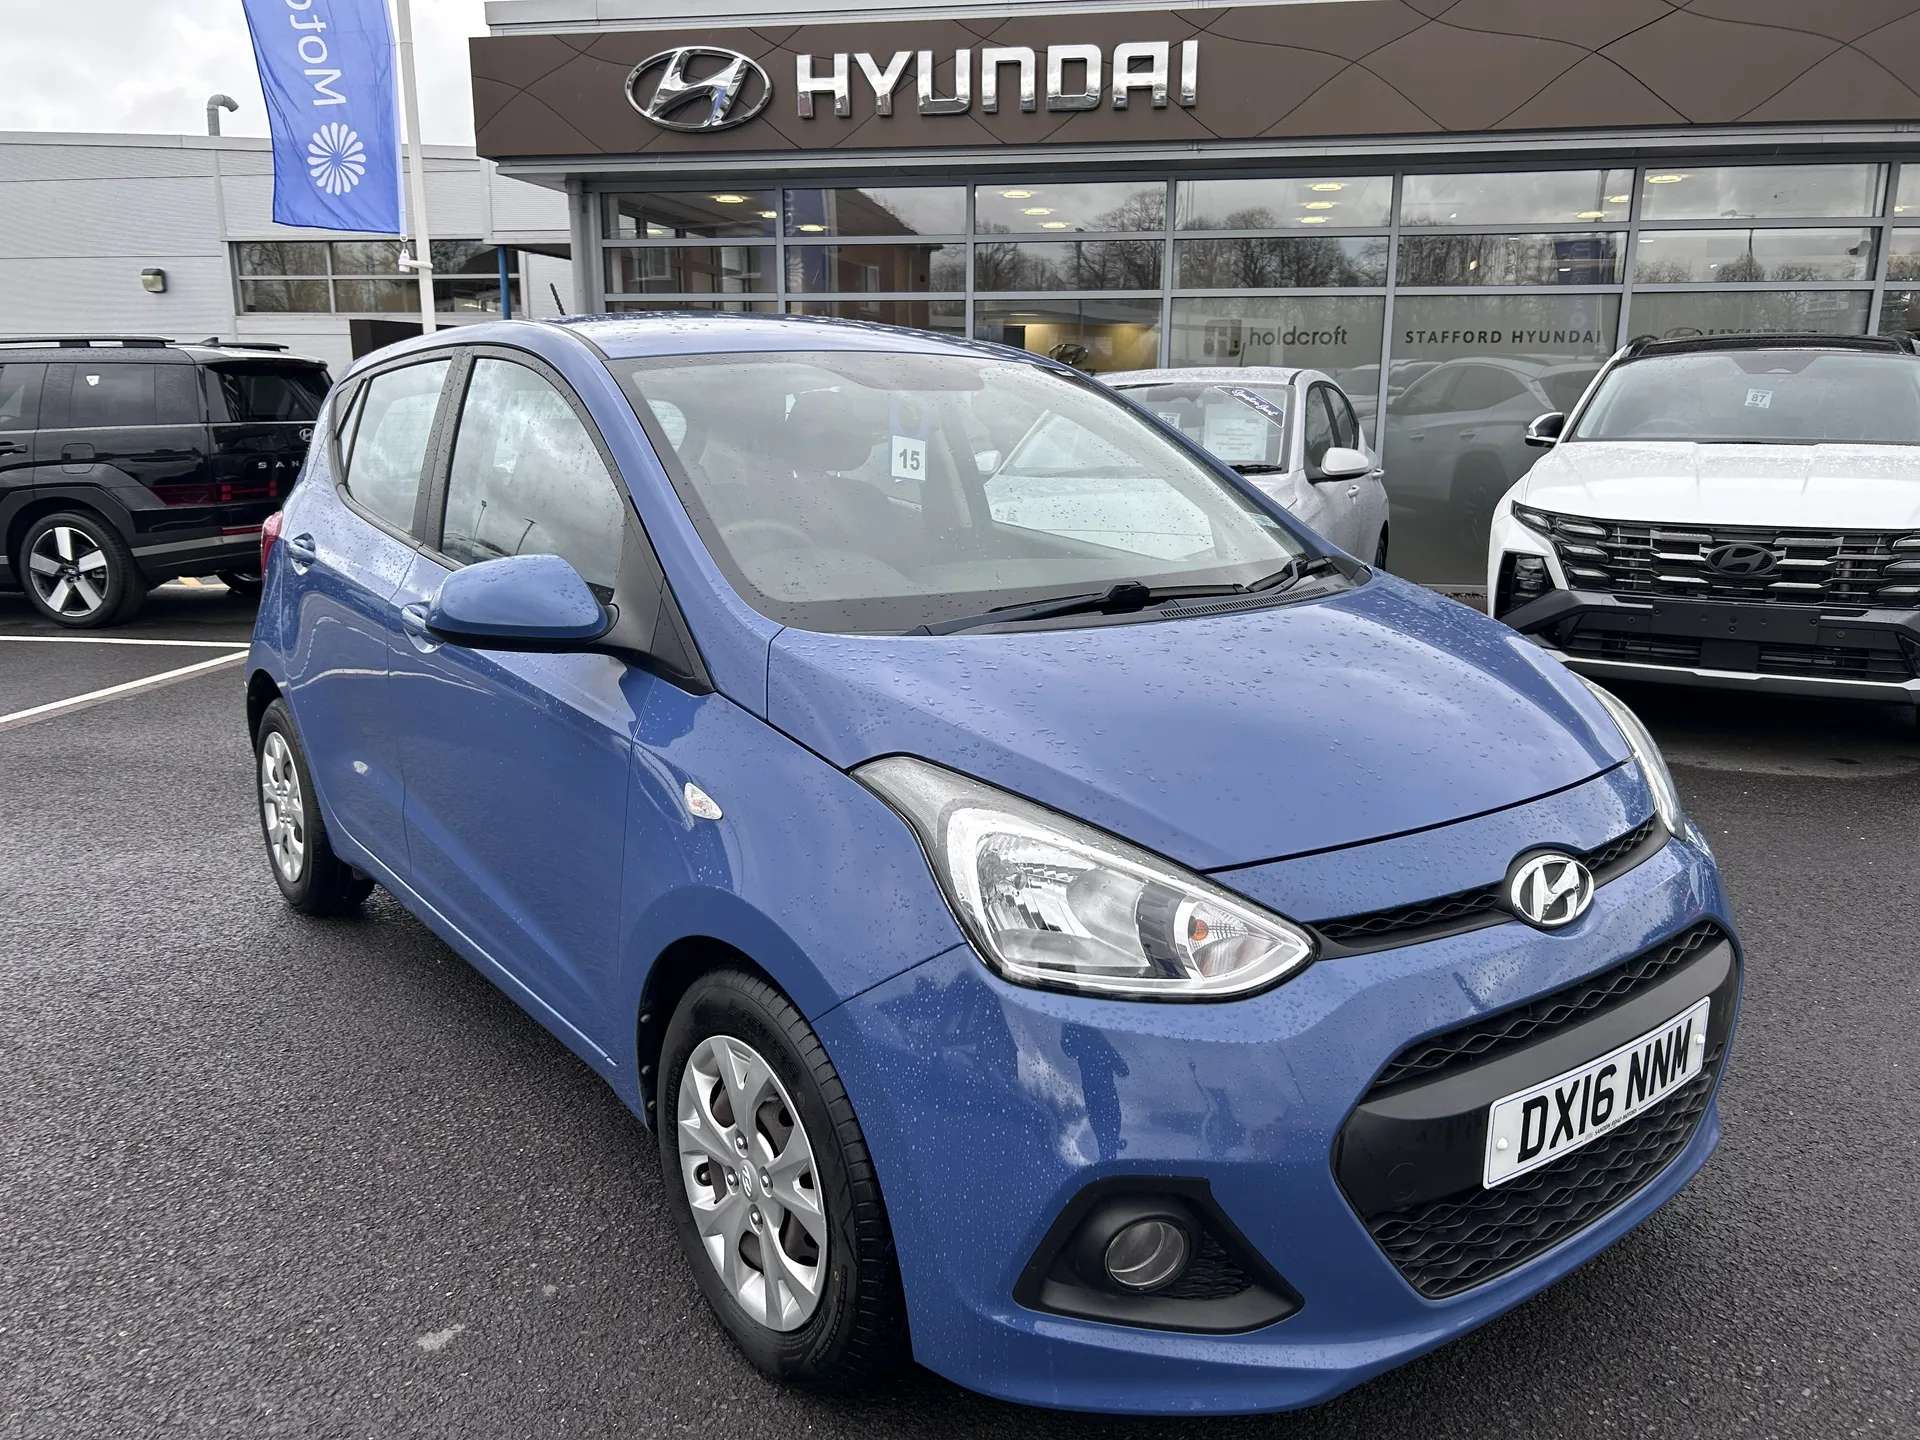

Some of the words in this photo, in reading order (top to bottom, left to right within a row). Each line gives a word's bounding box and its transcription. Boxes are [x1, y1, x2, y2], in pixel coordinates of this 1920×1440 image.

[796, 40, 1199, 119] HYUNDAI
[1250, 325, 1348, 346] holdcroft
[1405, 330, 1503, 344] STAFFORD
[1511, 330, 1601, 344] HYUNDAI
[899, 448, 921, 471] 15
[1517, 1063, 1618, 1164] DX16
[1625, 1018, 1693, 1110] NNM
